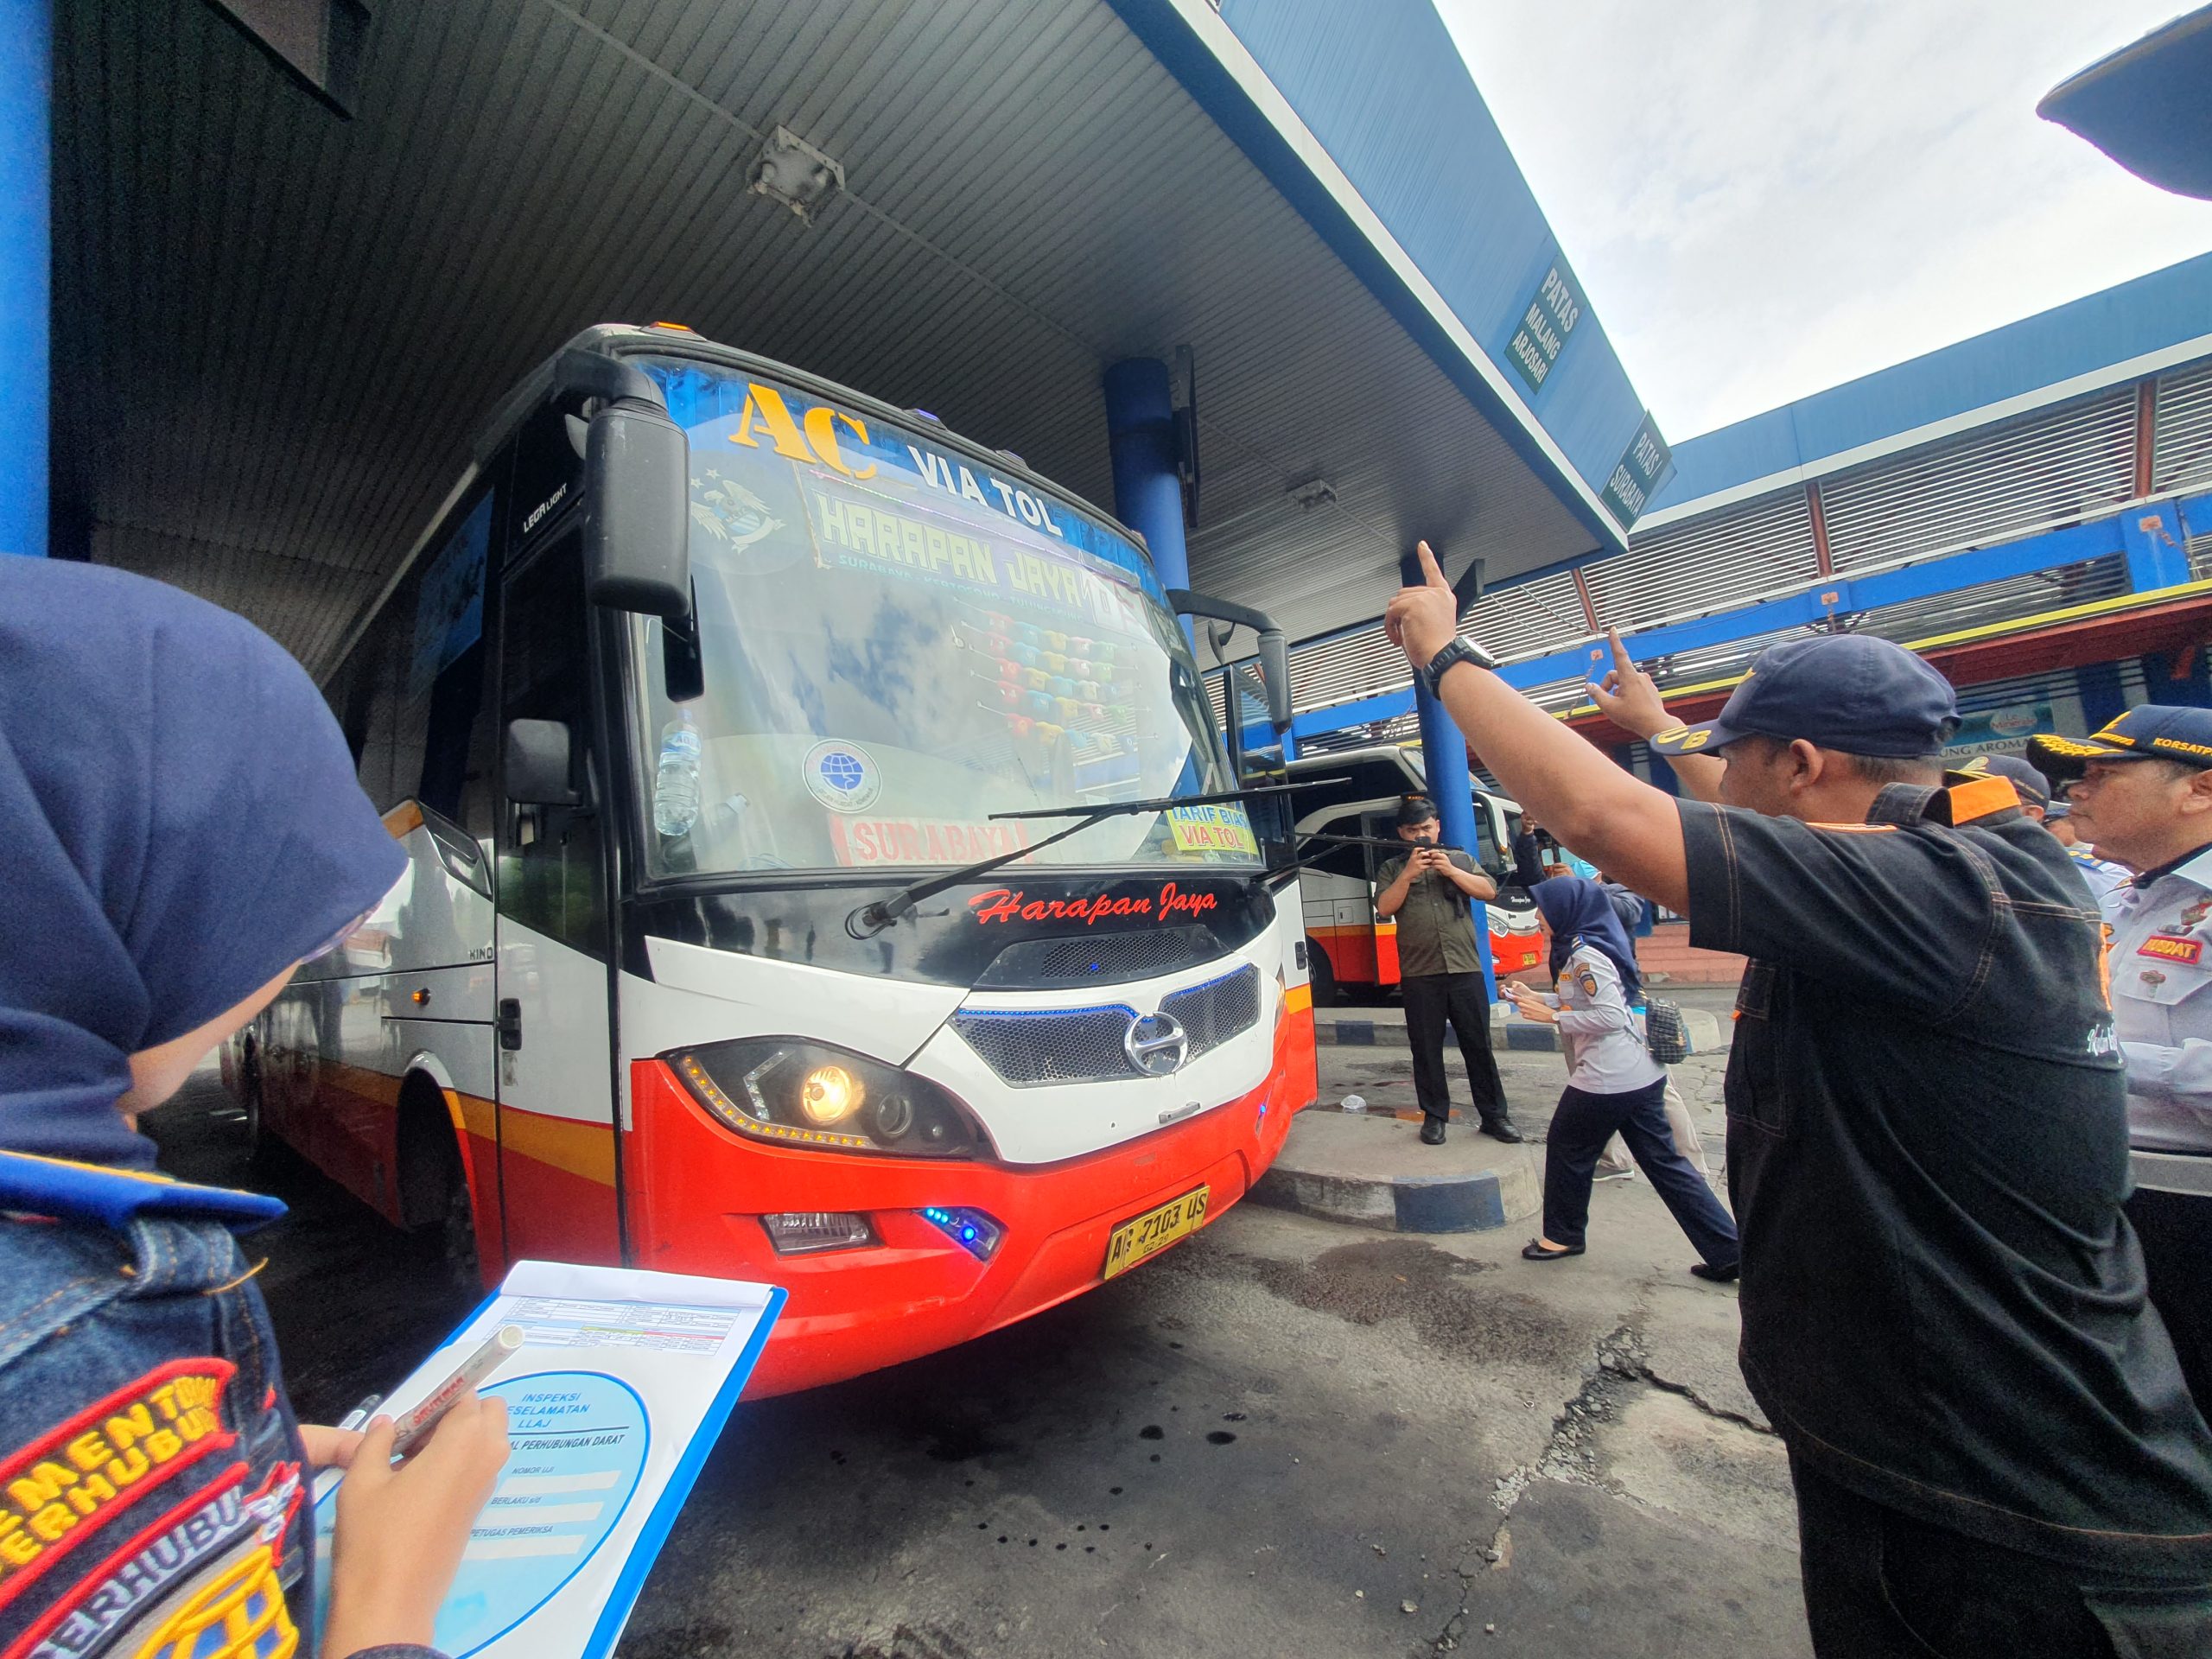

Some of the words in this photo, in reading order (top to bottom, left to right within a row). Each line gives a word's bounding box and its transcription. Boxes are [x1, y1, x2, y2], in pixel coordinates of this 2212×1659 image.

[1541, 267, 1579, 333] PATAS
[1524, 302, 1561, 361] MALANG
[1511, 329, 1549, 385] ARJOSARI
[728, 382, 877, 480] AC
[907, 445, 989, 507] VIA
[990, 477, 1064, 537] TOL
[1610, 463, 1646, 519] SURABAYA
[815, 493, 998, 585] HARAPAN
[1005, 550, 1083, 608] JAYA
[2152, 737, 2212, 757] KORSATP
[1173, 807, 1217, 823] TARIF
[1219, 809, 1249, 830] BIAS
[853, 822, 1014, 861] SURABAYA
[1179, 824, 1214, 847] VIA
[1213, 827, 1245, 849] TOL
[968, 888, 1152, 925] Harapan
[1159, 882, 1217, 921] Jaya
[1139, 1203, 1182, 1243] 7103
[1186, 1192, 1207, 1221] US
[507, 1404, 591, 1416] ESELAMATAN
[521, 1393, 582, 1403] INSPEKSI
[518, 1419, 552, 1429] LLAJ
[521, 1436, 593, 1451] PERHUBUNGAN
[592, 1433, 626, 1446] DARAT
[512, 1466, 541, 1475] NOMOR
[490, 1497, 530, 1505] BERLAKU
[470, 1528, 506, 1537] PETUGAS
[507, 1525, 554, 1535] PEMERIKSA
